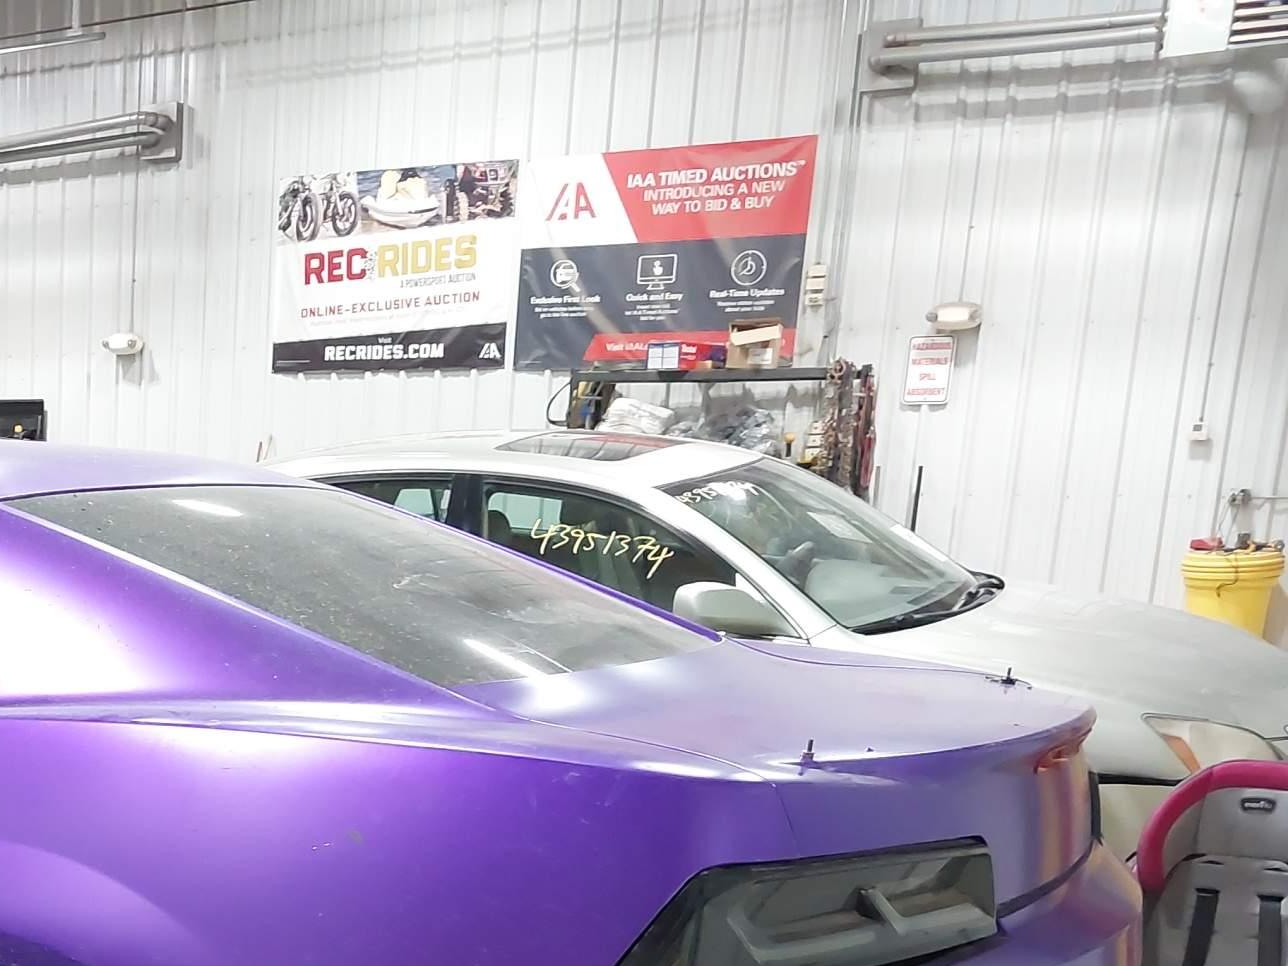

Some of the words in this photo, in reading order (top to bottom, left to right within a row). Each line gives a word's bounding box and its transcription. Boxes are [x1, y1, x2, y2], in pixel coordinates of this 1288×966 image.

[626, 173, 656, 189] IAA
[659, 169, 708, 186] TIMED
[643, 183, 734, 202] INTRODUCING
[737, 182, 748, 194] A
[752, 180, 785, 193] NEW
[651, 201, 681, 216] WAY
[683, 200, 702, 214] TO
[704, 198, 727, 212] BID
[729, 197, 742, 211] &
[744, 195, 775, 210] BUY
[377, 234, 477, 279] RIDES
[301, 296, 420, 318] ONLINE-EXCLUSIVE
[424, 291, 480, 306] AUCTION
[626, 293, 648, 302] Quick
[649, 293, 664, 301] and
[665, 292, 683, 302] Easy
[324, 342, 444, 362] RECRIDES.COM
[529, 517, 675, 580] 43951374
